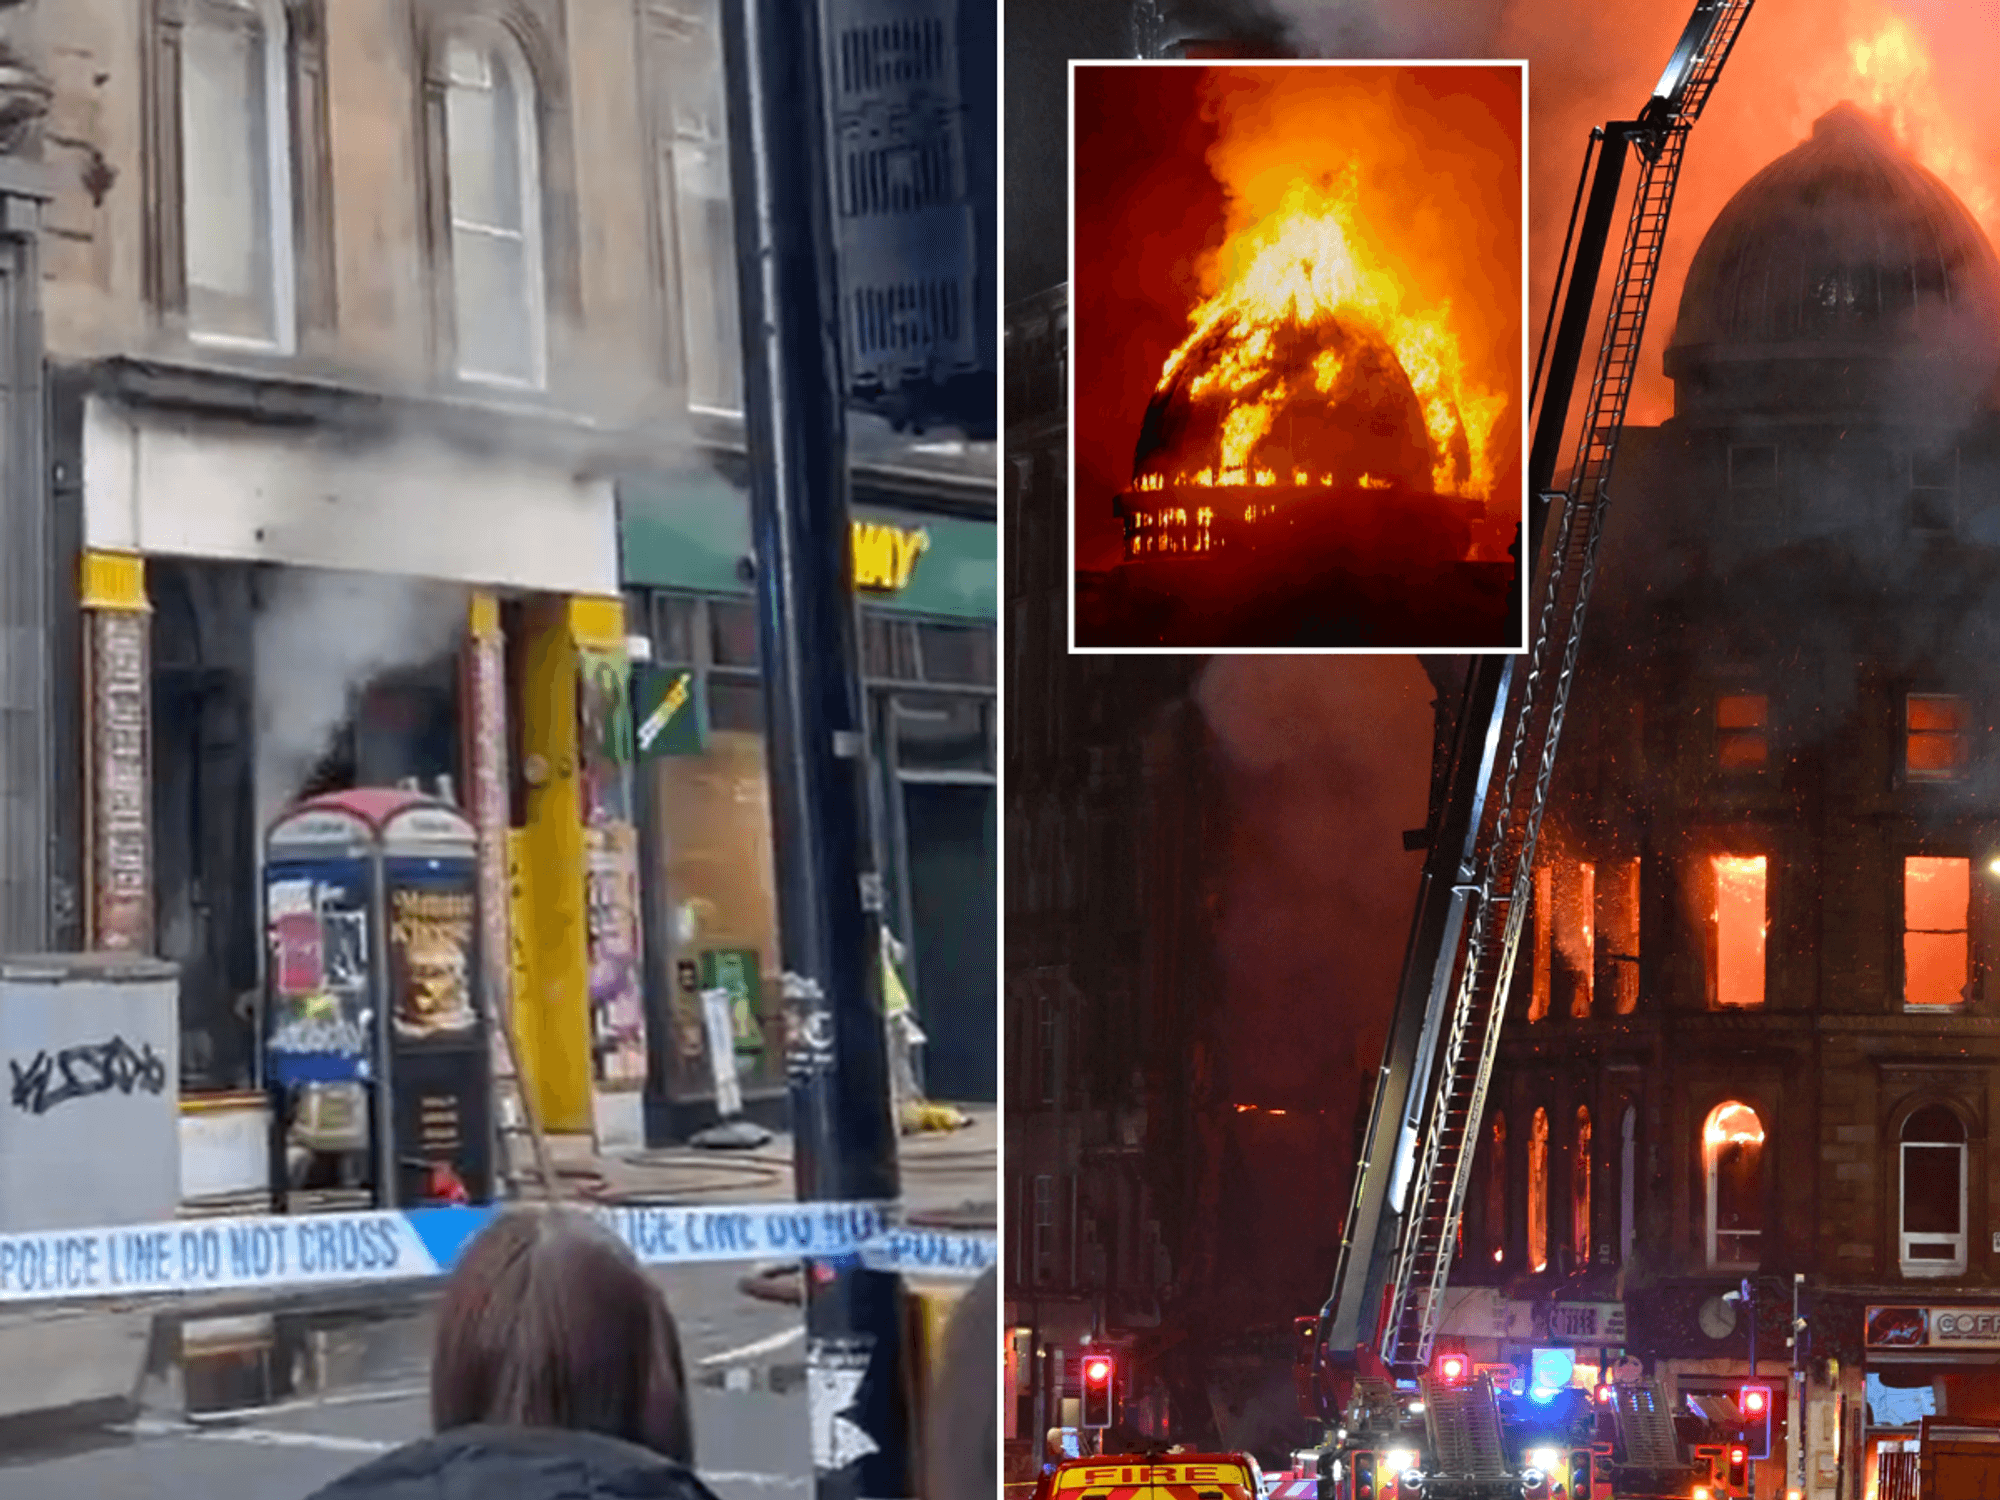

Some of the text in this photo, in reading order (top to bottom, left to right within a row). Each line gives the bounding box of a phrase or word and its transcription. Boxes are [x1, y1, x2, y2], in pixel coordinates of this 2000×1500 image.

[0, 1218, 399, 1291] POLICE LINE DO NOT CROSS
[1085, 1466, 1219, 1484] FIRE
